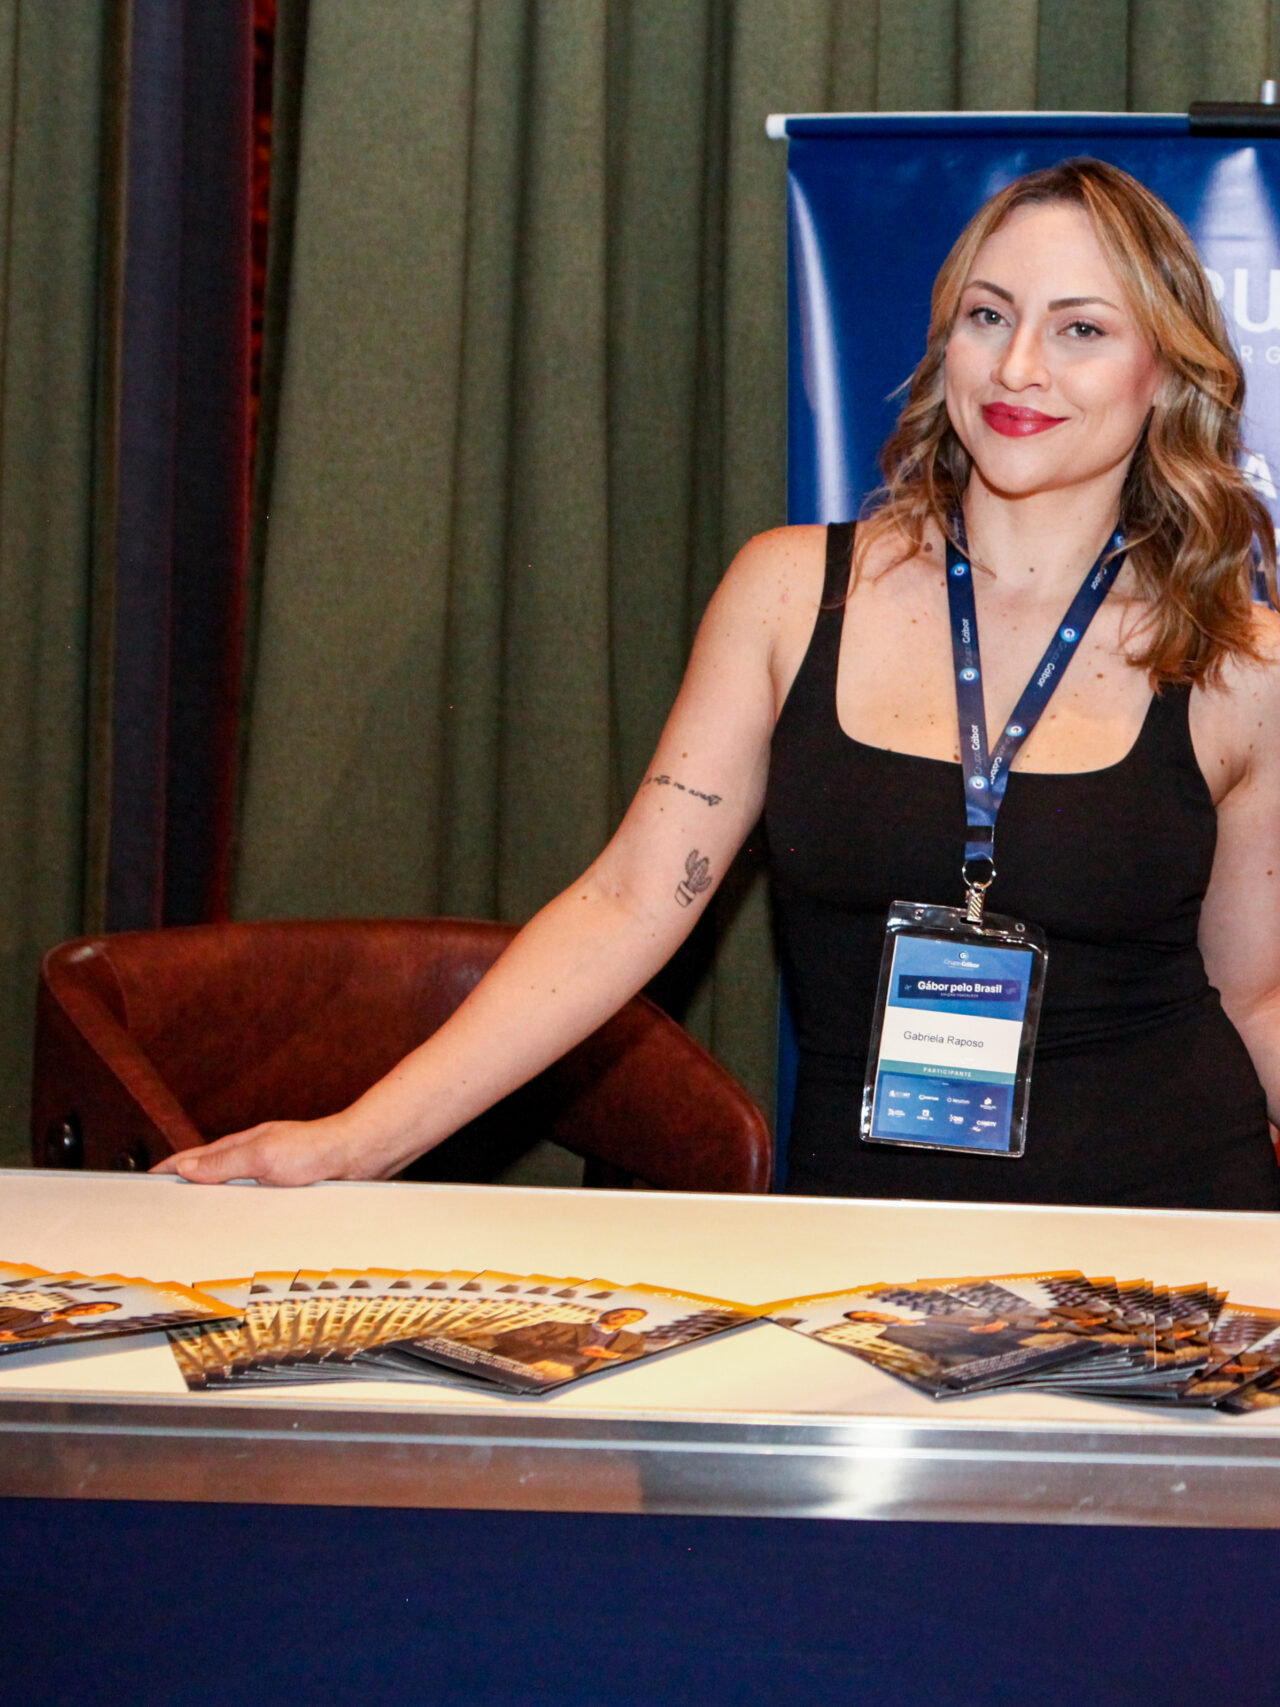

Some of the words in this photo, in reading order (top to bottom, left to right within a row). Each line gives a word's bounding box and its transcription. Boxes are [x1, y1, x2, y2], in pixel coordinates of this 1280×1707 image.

[917, 980, 949, 991] Gábor
[950, 983, 973, 993] pelo
[974, 983, 1003, 994] Brasil
[903, 1030, 945, 1044] Gabriela
[947, 1035, 984, 1048] Raposo
[923, 1066, 972, 1078] PARTICIPANTE
